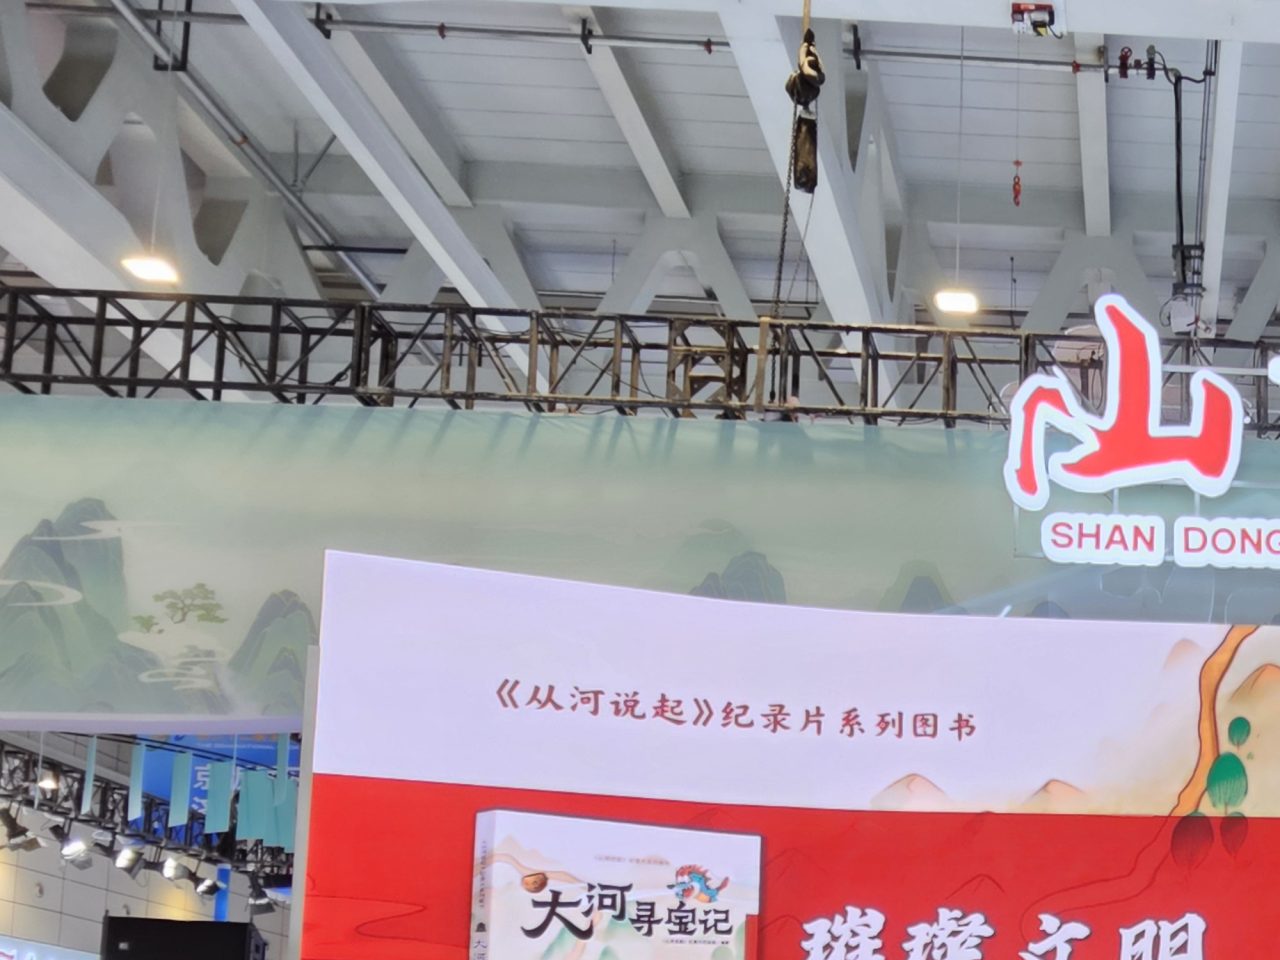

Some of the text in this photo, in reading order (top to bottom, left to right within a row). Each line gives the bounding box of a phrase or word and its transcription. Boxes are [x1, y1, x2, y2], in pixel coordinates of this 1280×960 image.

[1050, 521, 1156, 553] SHAN
[495, 679, 977, 742] 《从河说起》纪录片系列图书
[520, 882, 733, 940] 大河寻宝记
